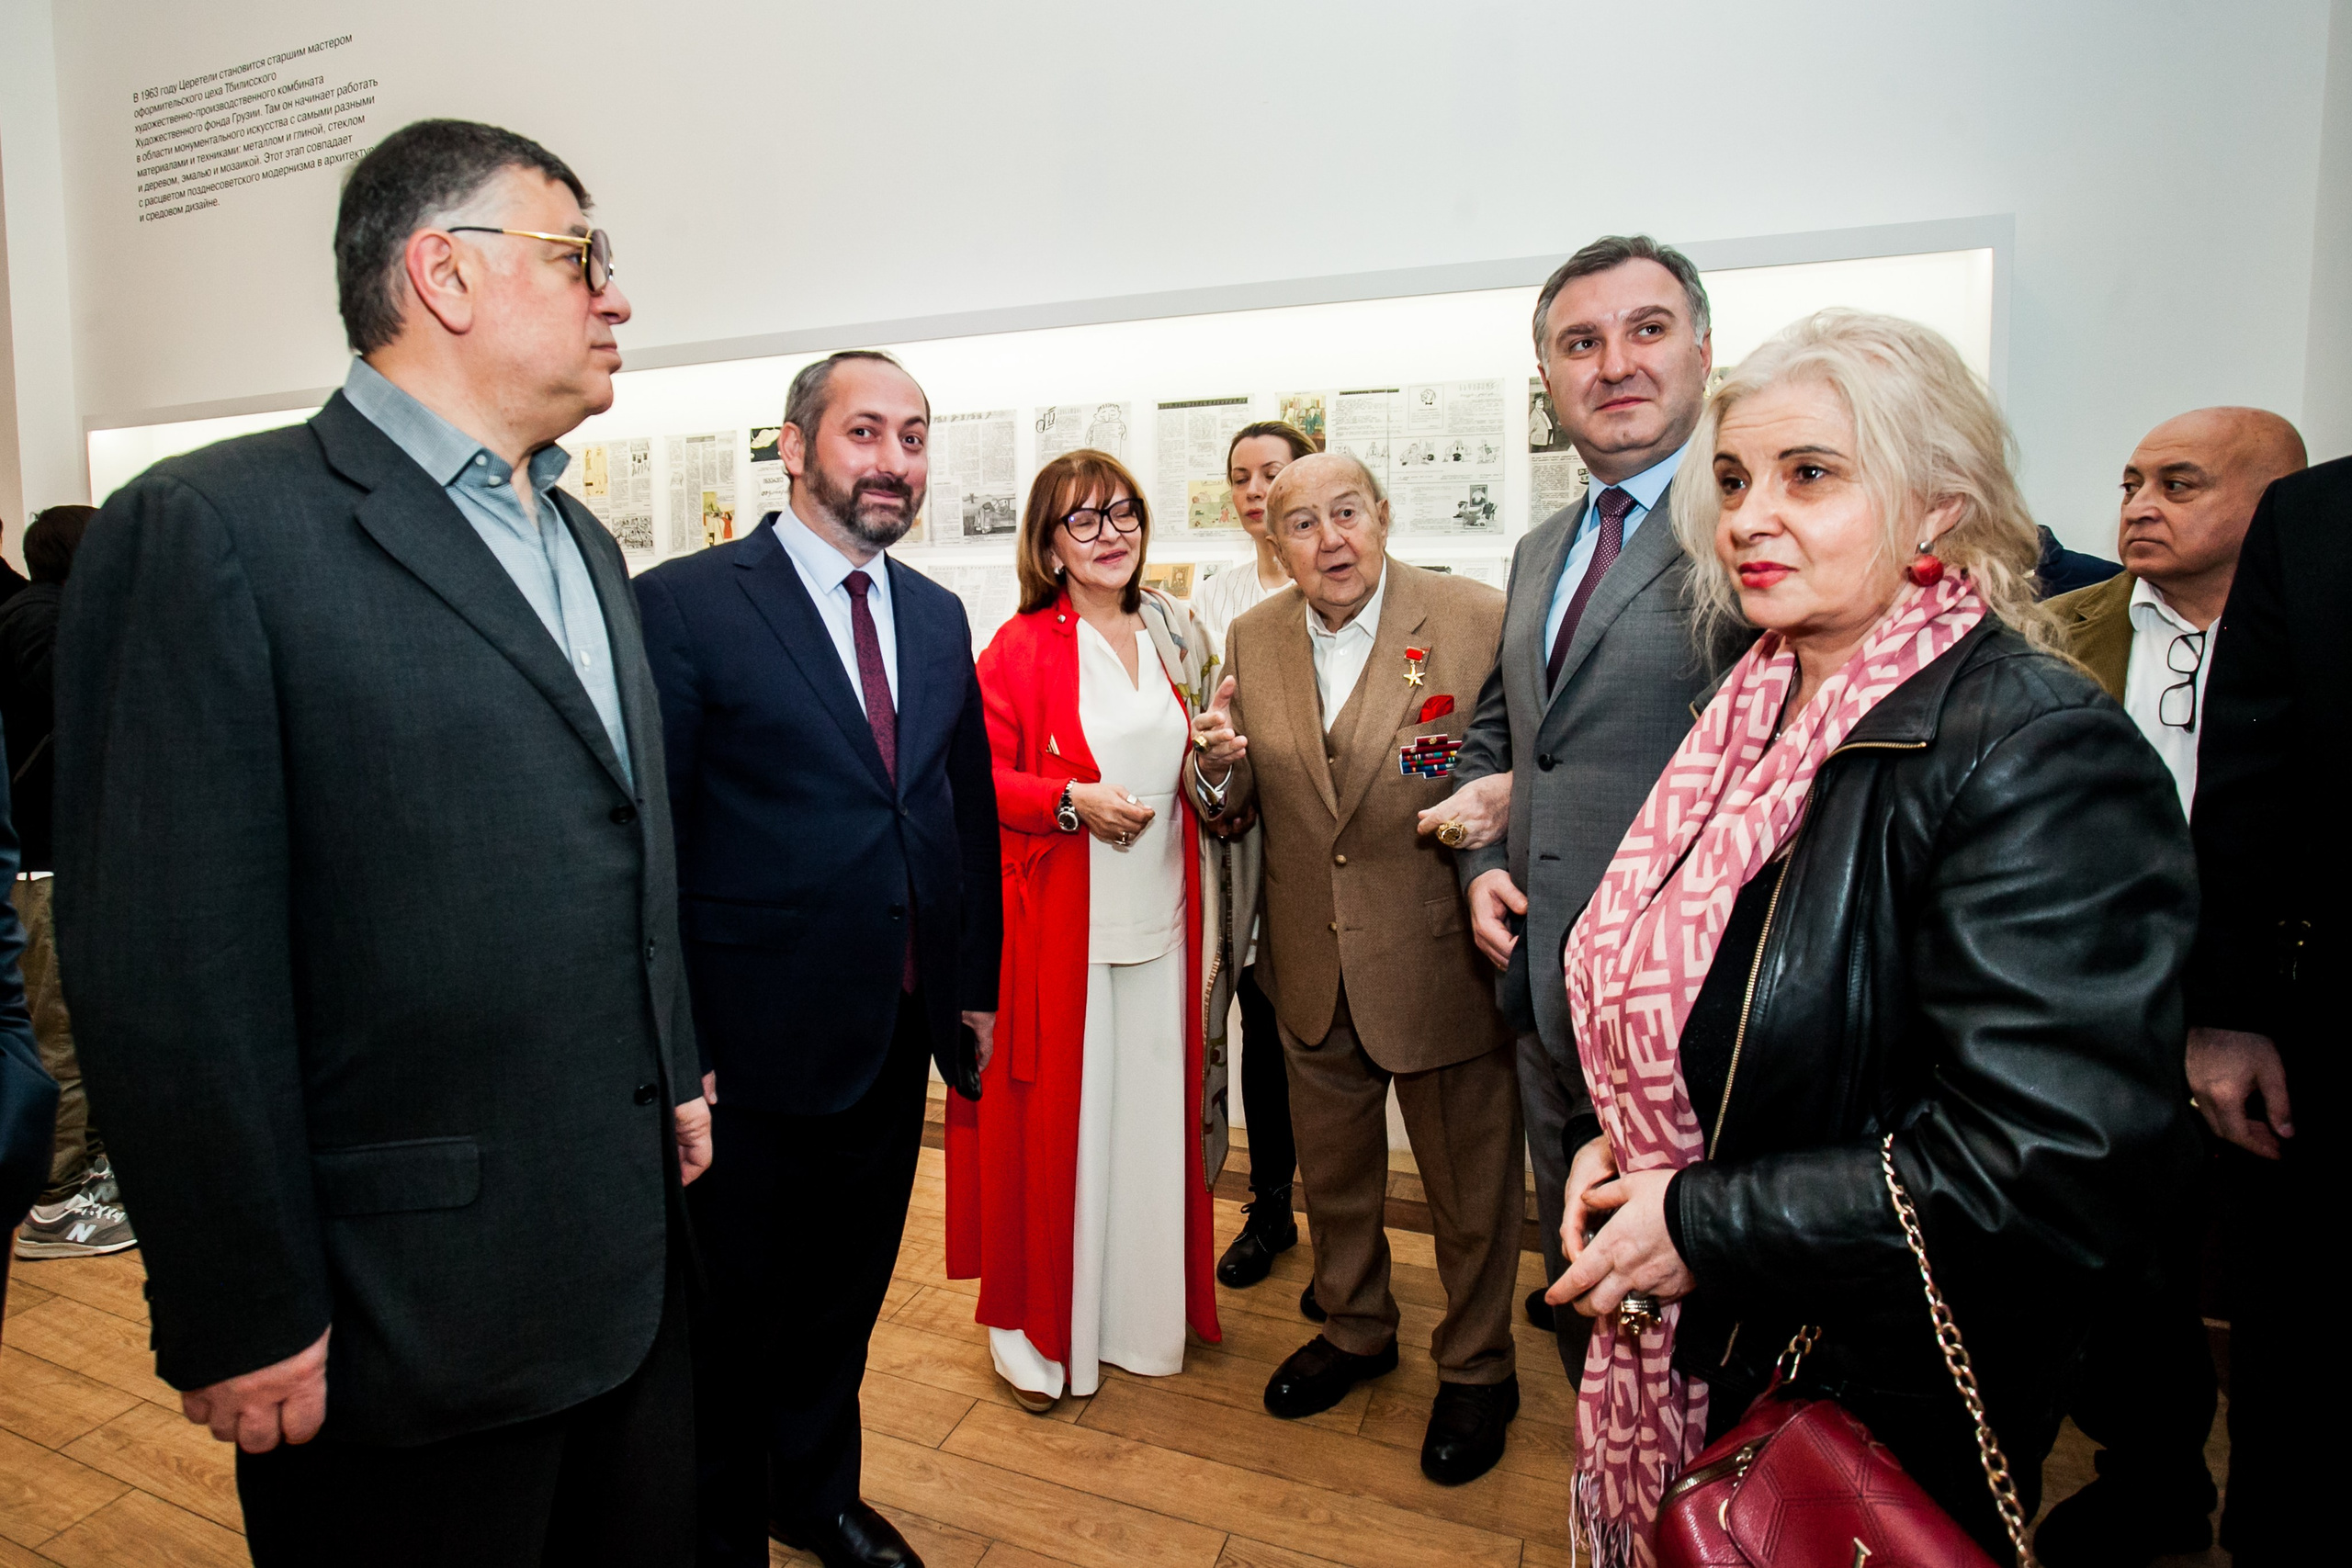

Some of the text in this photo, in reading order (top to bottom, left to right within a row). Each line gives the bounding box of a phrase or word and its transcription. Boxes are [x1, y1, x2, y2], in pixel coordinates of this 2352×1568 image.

[133, 34, 352, 103] В 1963 году Церетели становится старшим мастером
[134, 72, 276, 118] оформительского цеха Тбилисского
[135, 75, 324, 133] художественно-производственного комбината
[135, 78, 378, 148] Художественного фонда Грузии. Там он начинает работать
[136, 96, 375, 163] в области монументального искусства с самыми разными
[137, 158, 188, 178] материалами
[197, 146, 241, 163] техниками:
[243, 135, 284, 152] металлом
[294, 124, 325, 140] глиной,
[328, 115, 365, 132] стеклом
[138, 134, 352, 193] и деревом, эмалью и мозаикой. Этот этап совпадает
[139, 197, 220, 222] и средовом дизайне.
[145, 190, 185, 208] расцветом
[187, 173, 260, 197] позднесоветского
[262, 159, 315, 179] модернизма
[317, 158, 322, 167] в
[65, 1223, 96, 1243] N
